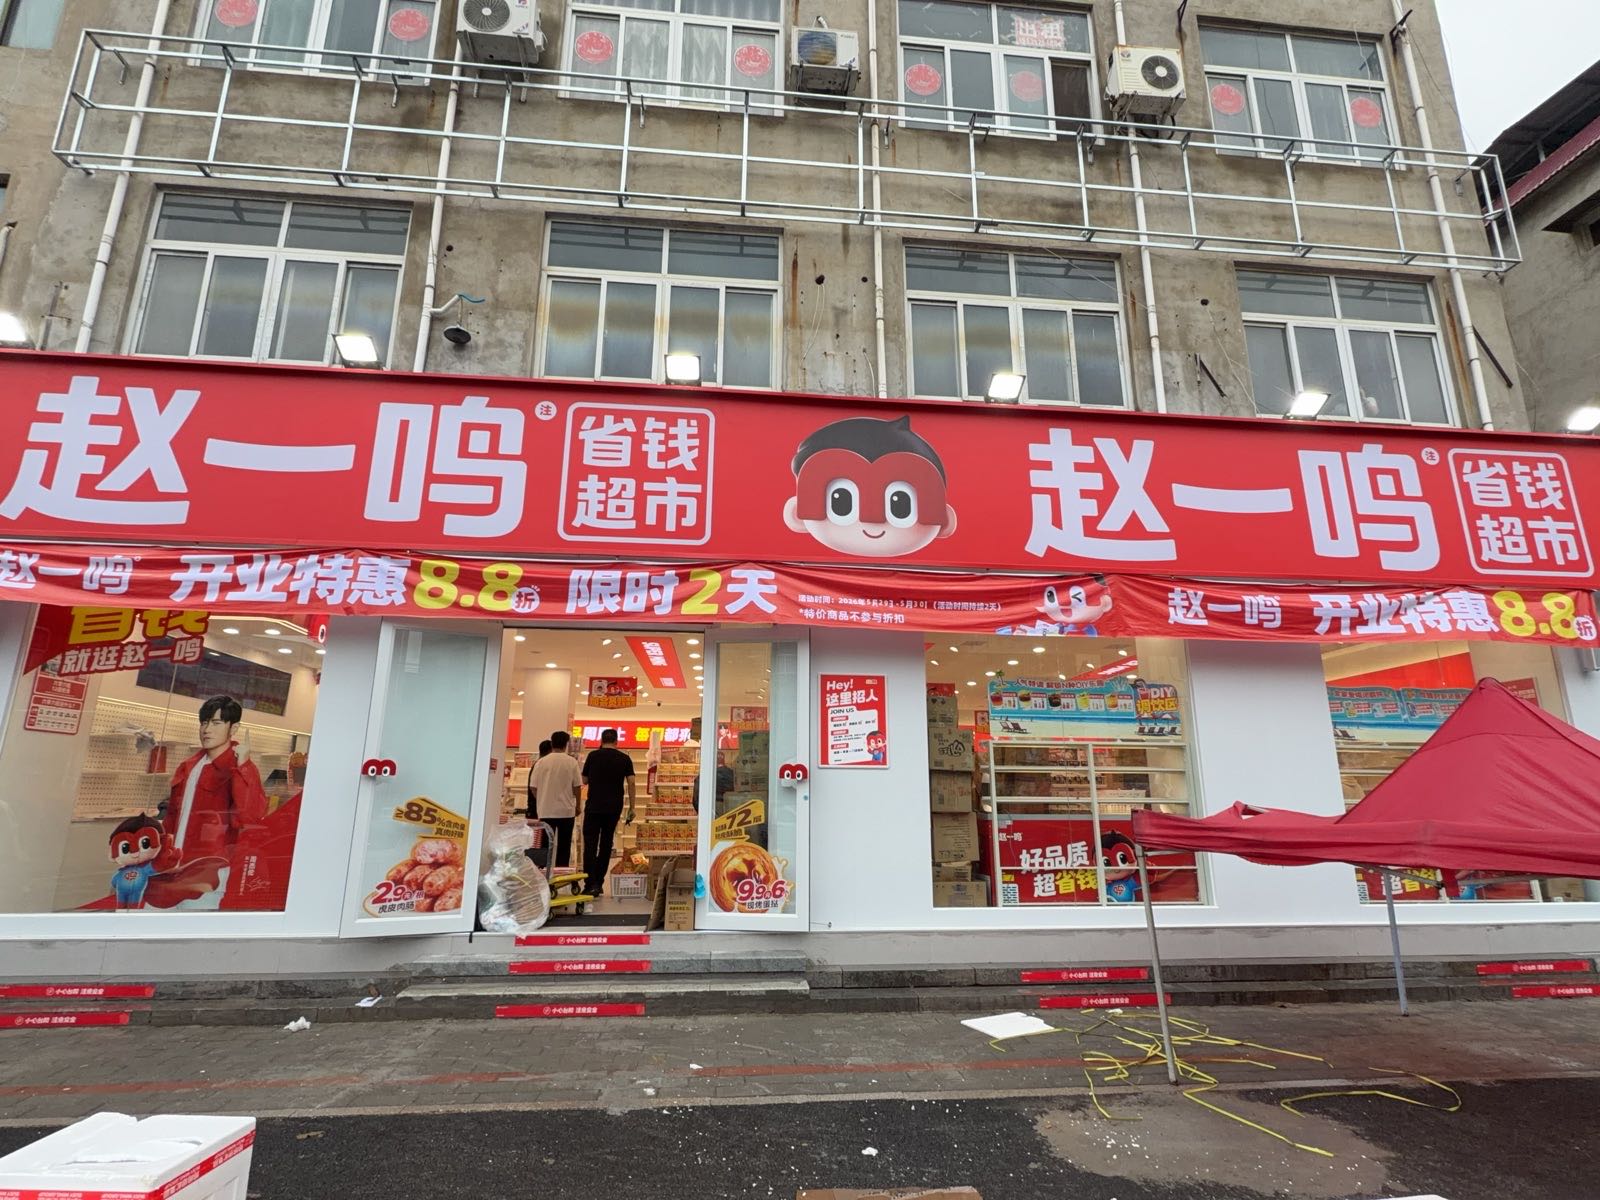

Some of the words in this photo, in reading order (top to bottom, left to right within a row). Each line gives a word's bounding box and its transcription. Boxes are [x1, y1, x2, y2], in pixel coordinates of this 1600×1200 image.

[0, 375, 527, 538] 赵一鸣
[577, 415, 700, 472] 省钱
[572, 474, 703, 534] 超市
[1024, 427, 1442, 573] 赵一鸣
[1460, 458, 1566, 513] 省钱
[1474, 515, 1581, 571] 超市
[0, 549, 133, 595] 赵一鸣
[566, 564, 778, 616] 限时2天
[1167, 587, 1282, 629] 赵一鸣
[61, 638, 201, 675] 就逛赵一鸣
[826, 679, 853, 691] Hey!
[826, 689, 878, 707] 这里招人
[1136, 697, 1178, 715] 调饮区
[1150, 686, 1174, 698] DIY
[1019, 840, 1090, 874] 好品质
[1033, 869, 1099, 898] 超省钱
